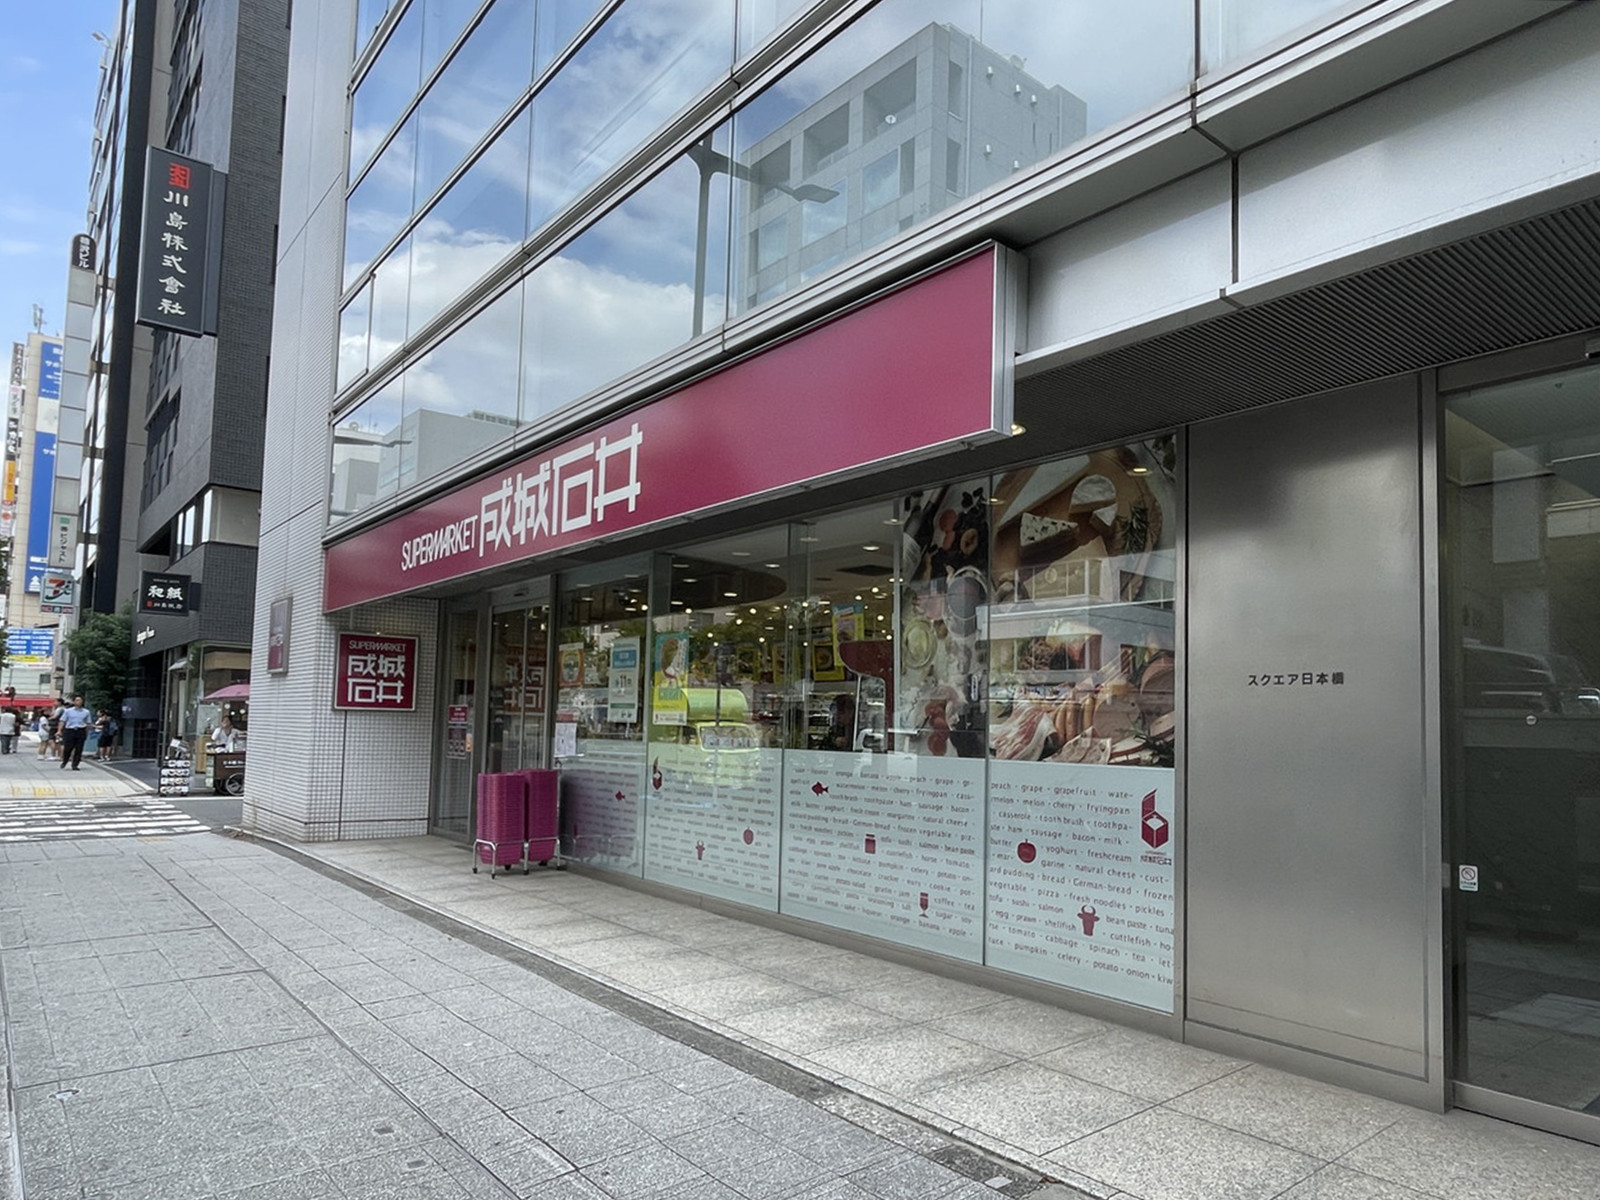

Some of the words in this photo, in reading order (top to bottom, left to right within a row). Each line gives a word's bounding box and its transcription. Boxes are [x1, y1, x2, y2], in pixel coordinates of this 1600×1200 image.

[401, 514, 478, 571] SUPERMARKET
[479, 423, 643, 558] 成城石井
[348, 640, 407, 652] SUPERMARKET
[347, 653, 406, 678] 成城
[1247, 671, 1346, 687] スクエア日本橋
[347, 678, 405, 704] 石井
[935, 778, 954, 786] grape
[1021, 785, 1043, 793] grape
[1054, 787, 1096, 796] grapefruit
[1023, 799, 1045, 807] melon
[1053, 801, 1075, 811] cherry
[1087, 803, 1130, 815] fryingpan
[946, 819, 968, 827] cheese
[999, 812, 1031, 820] casserole
[1094, 821, 1132, 831] toothpa-
[1008, 825, 1023, 833] ham
[1031, 829, 1062, 840] sausage
[1072, 833, 1095, 842] bacon
[1104, 837, 1122, 845] milk
[1046, 846, 1077, 856] yoghurt
[1042, 873, 1065, 884] bread
[1073, 878, 1131, 895] German-bread
[1075, 865, 1103, 874] natural
[1107, 869, 1136, 879] cheese
[1145, 875, 1168, 884] cust-
[989, 881, 1026, 892] vegetable
[1038, 889, 1059, 898] pizza
[1069, 893, 1090, 903] fresh
[1093, 899, 1126, 910] noodles
[1135, 906, 1164, 917] pickles
[1038, 904, 1064, 913] salmon
[1106, 915, 1125, 925] bean
[1127, 921, 1147, 930] paste
[1009, 927, 1035, 938] tomato
[1045, 935, 1078, 948] cabbage
[1089, 944, 1120, 956] spinach
[1132, 953, 1145, 962] tea
[1110, 933, 1151, 946] cuttlefish
[1015, 943, 1047, 955] pumpkin
[1057, 953, 1081, 965] celery
[1093, 961, 1119, 972] potato
[1126, 969, 1150, 979] onion
